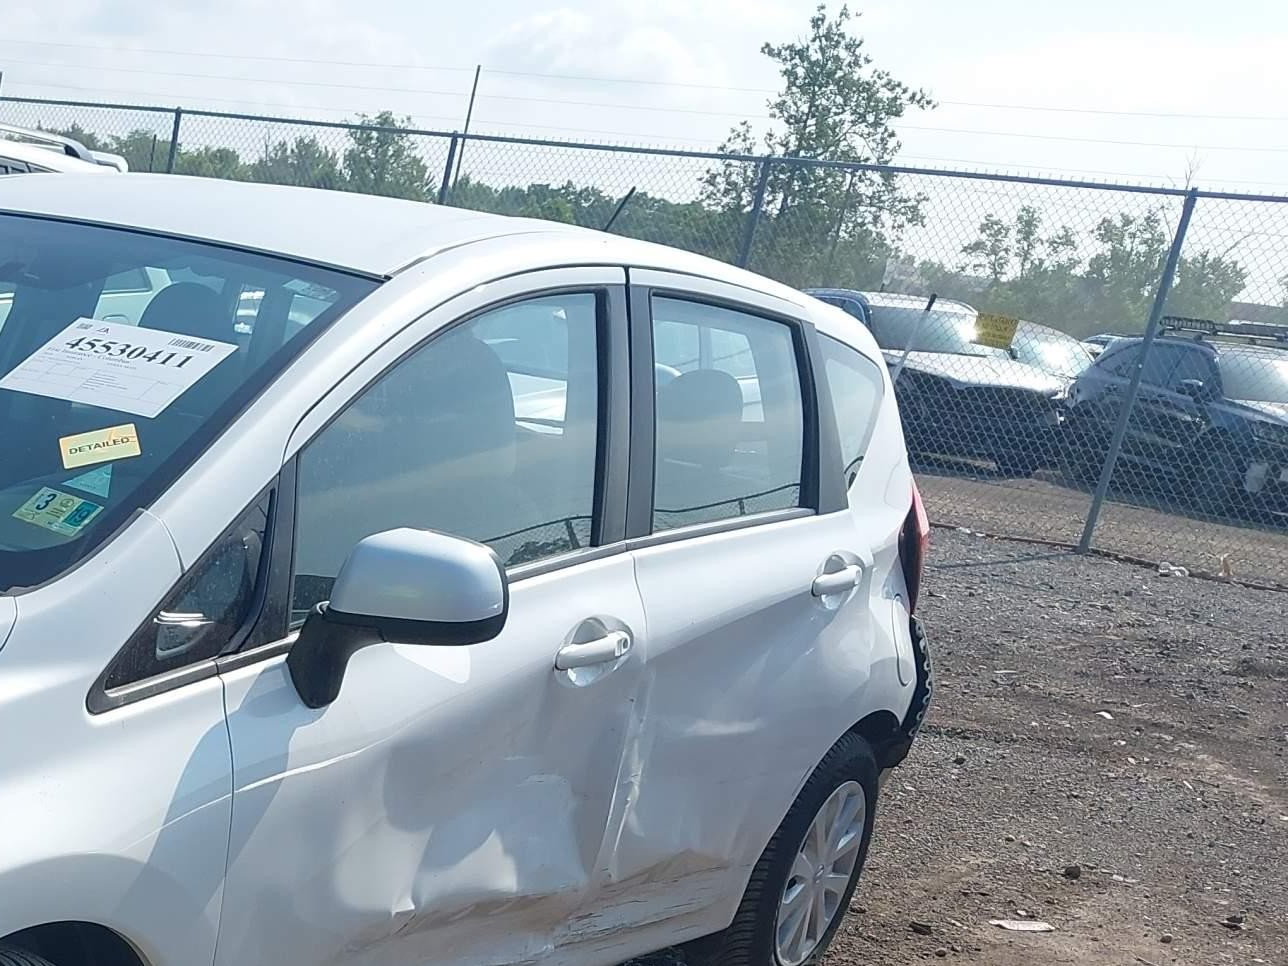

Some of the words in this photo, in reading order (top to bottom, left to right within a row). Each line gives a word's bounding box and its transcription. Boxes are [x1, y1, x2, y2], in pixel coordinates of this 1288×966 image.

[65, 336, 194, 369] 45530411
[68, 436, 131, 455] DETAILED
[35, 493, 58, 511] 3
